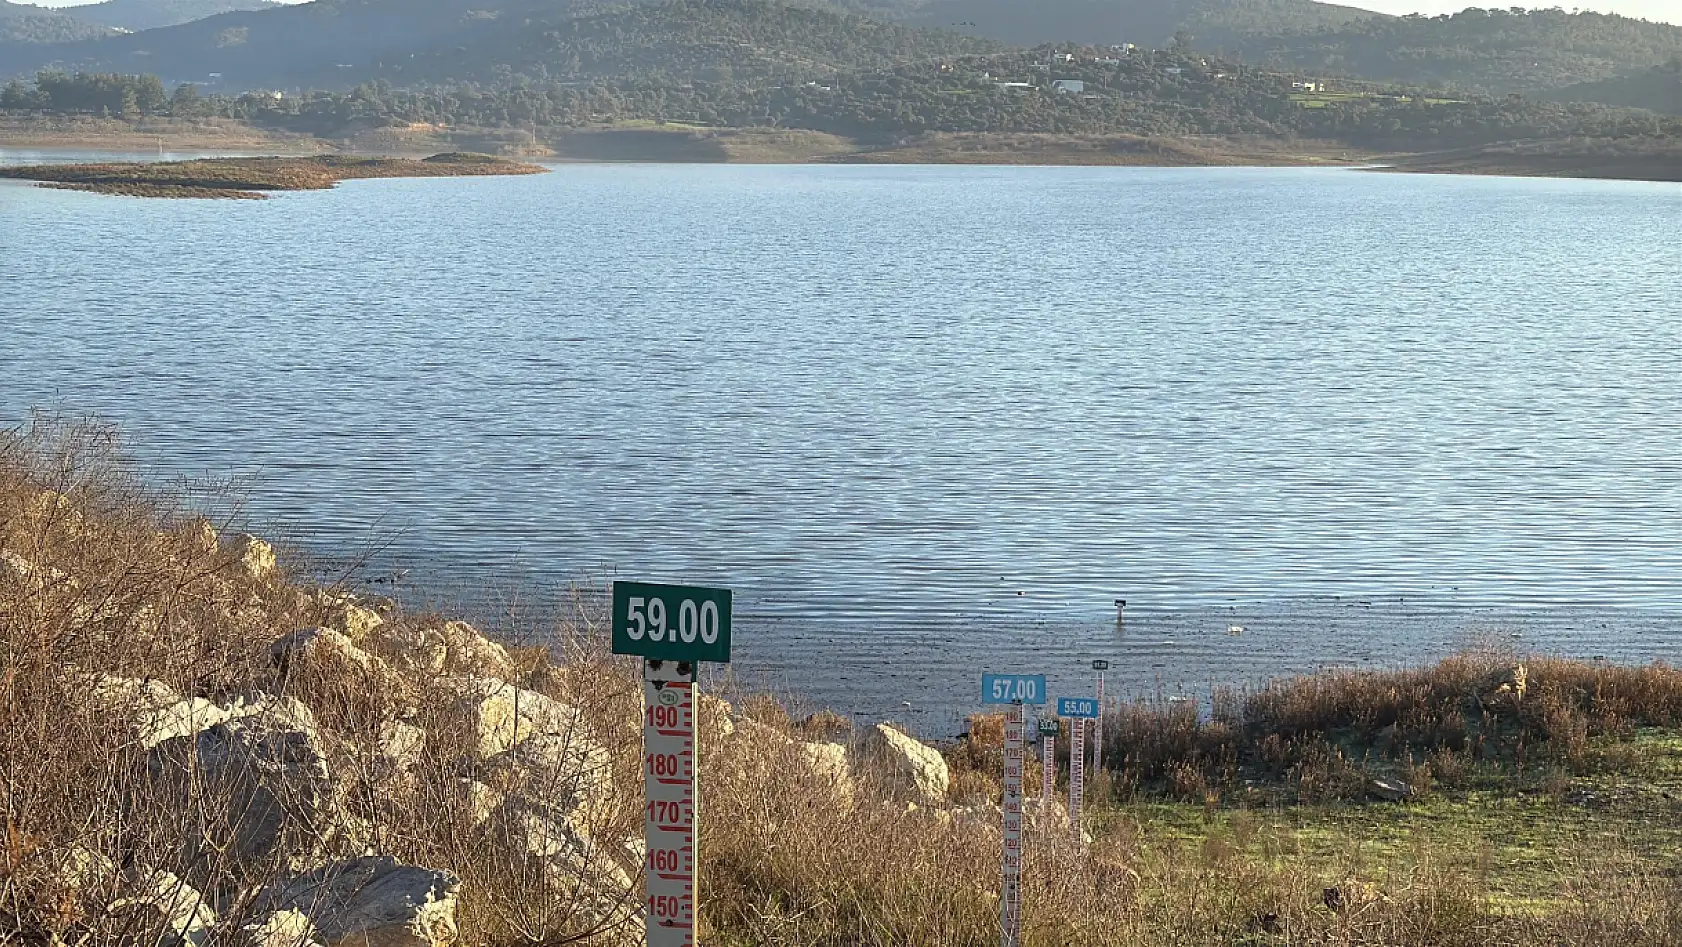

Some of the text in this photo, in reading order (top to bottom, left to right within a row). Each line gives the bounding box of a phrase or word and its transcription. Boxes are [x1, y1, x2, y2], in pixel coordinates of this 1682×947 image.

[626, 597, 719, 644] 59.00
[993, 679, 1036, 699] 57.00
[647, 705, 678, 728] 190
[1064, 701, 1092, 714] 55.00
[1005, 747, 1018, 757] 170
[647, 753, 678, 776] 180
[647, 800, 679, 823] 170
[648, 848, 678, 872] 160
[648, 895, 679, 918] 150
